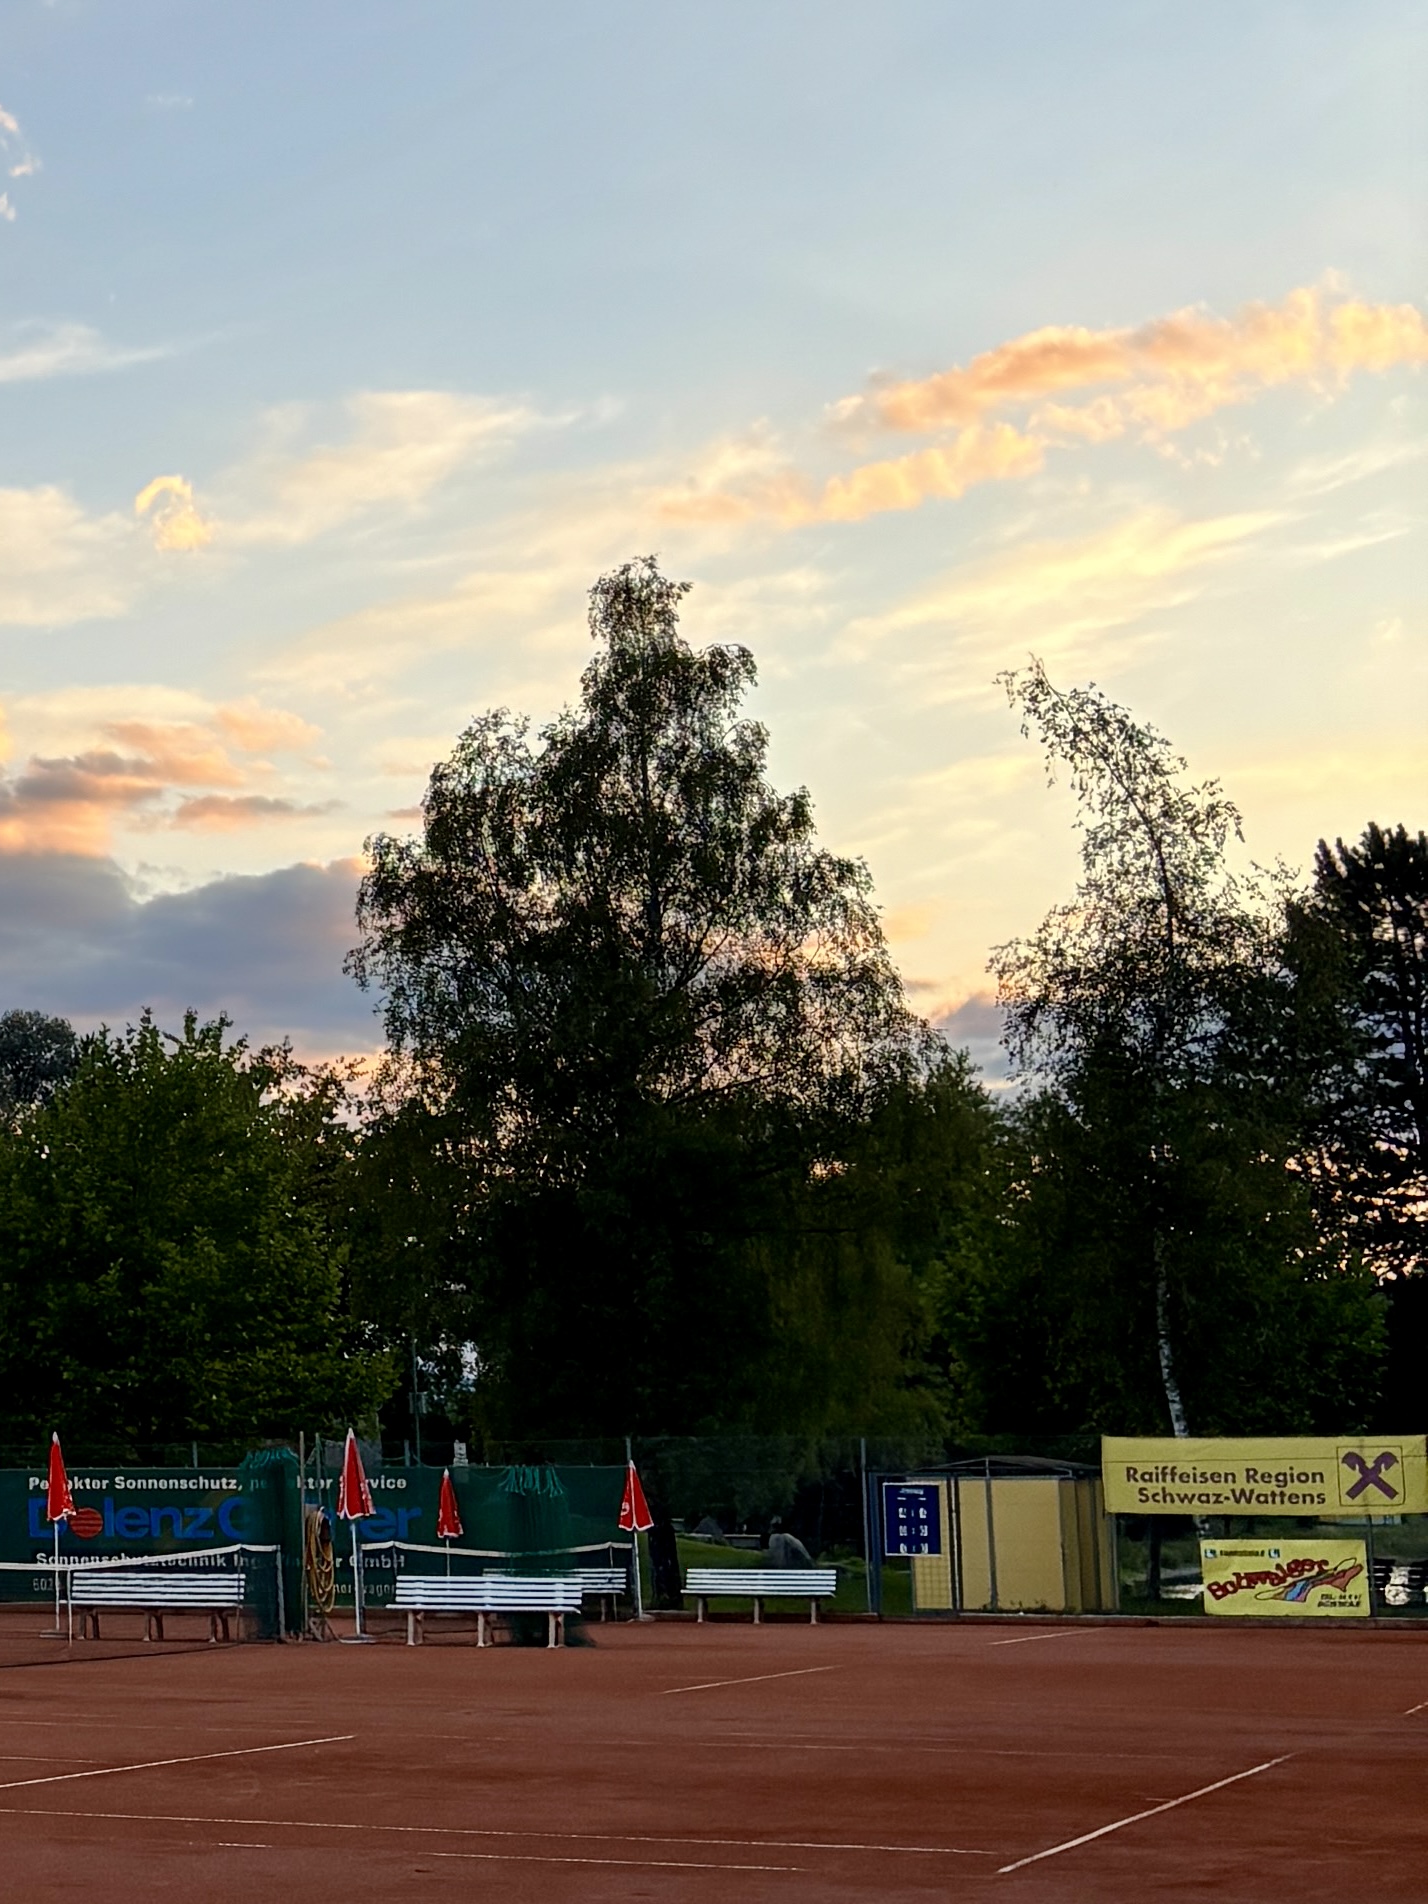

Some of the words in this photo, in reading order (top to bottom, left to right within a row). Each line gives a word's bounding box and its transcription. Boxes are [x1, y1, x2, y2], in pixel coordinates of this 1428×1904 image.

[1125, 1465, 1237, 1484] Raiffeisen
[1245, 1467, 1325, 1488] Region
[1138, 1487, 1327, 1505] Schwaz-Wattens
